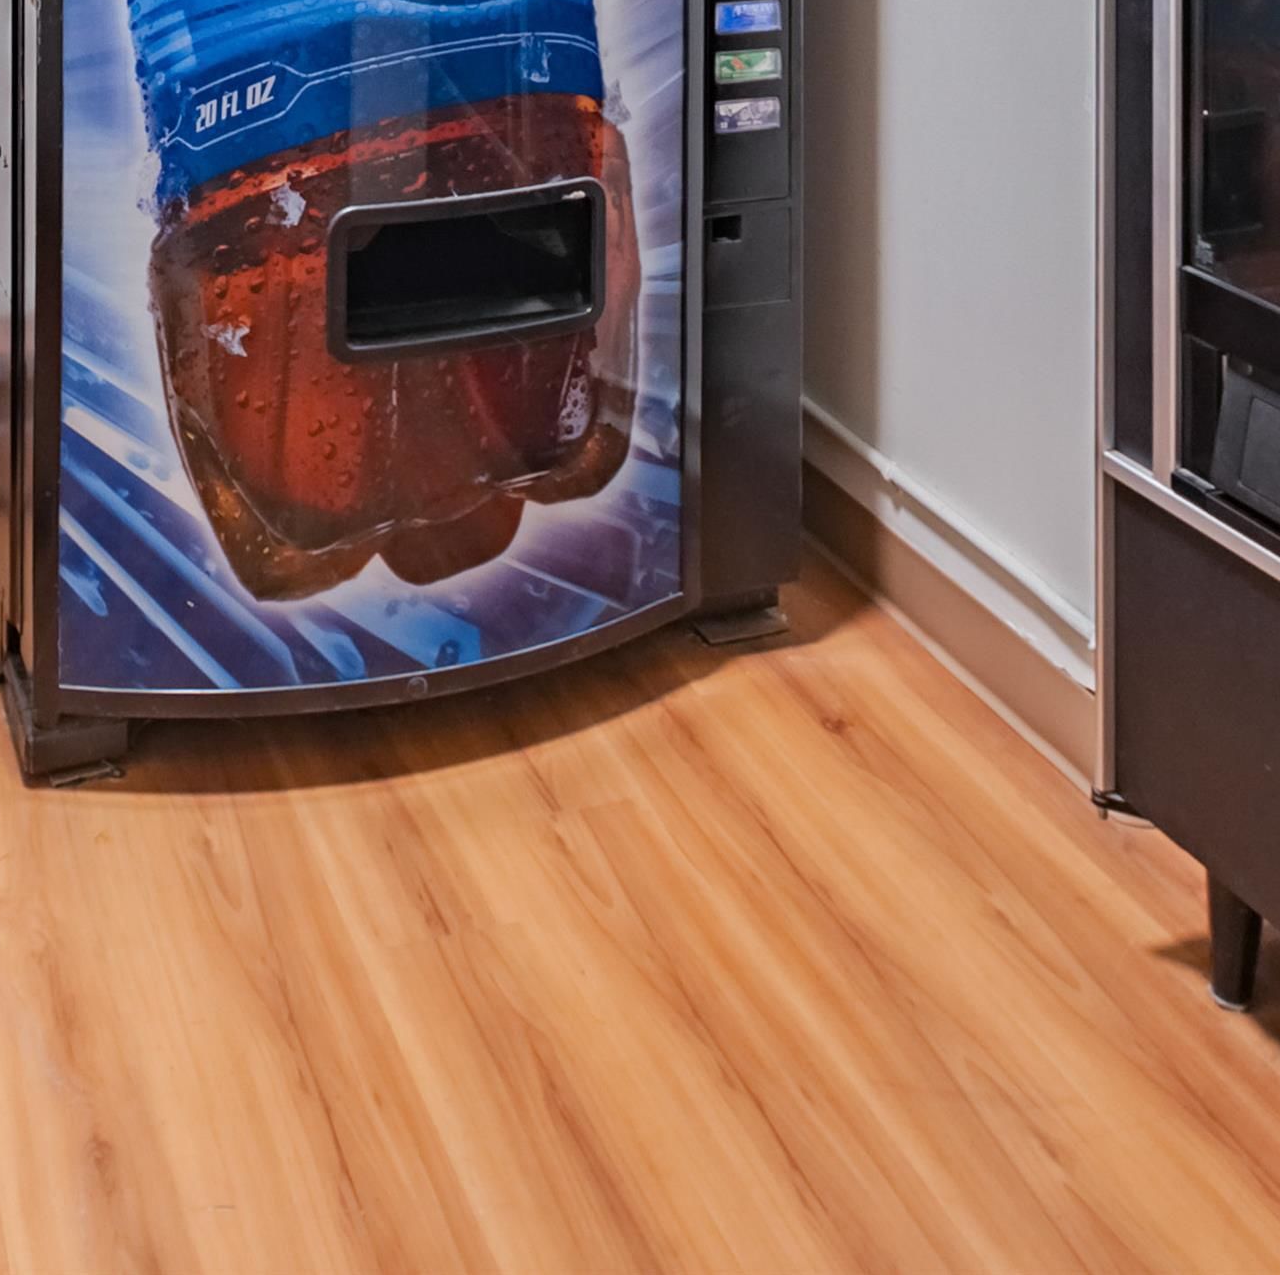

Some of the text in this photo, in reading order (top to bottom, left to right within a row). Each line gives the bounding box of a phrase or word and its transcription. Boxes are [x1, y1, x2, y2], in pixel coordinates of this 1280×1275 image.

[196, 75, 276, 134] 20 FL OZ
